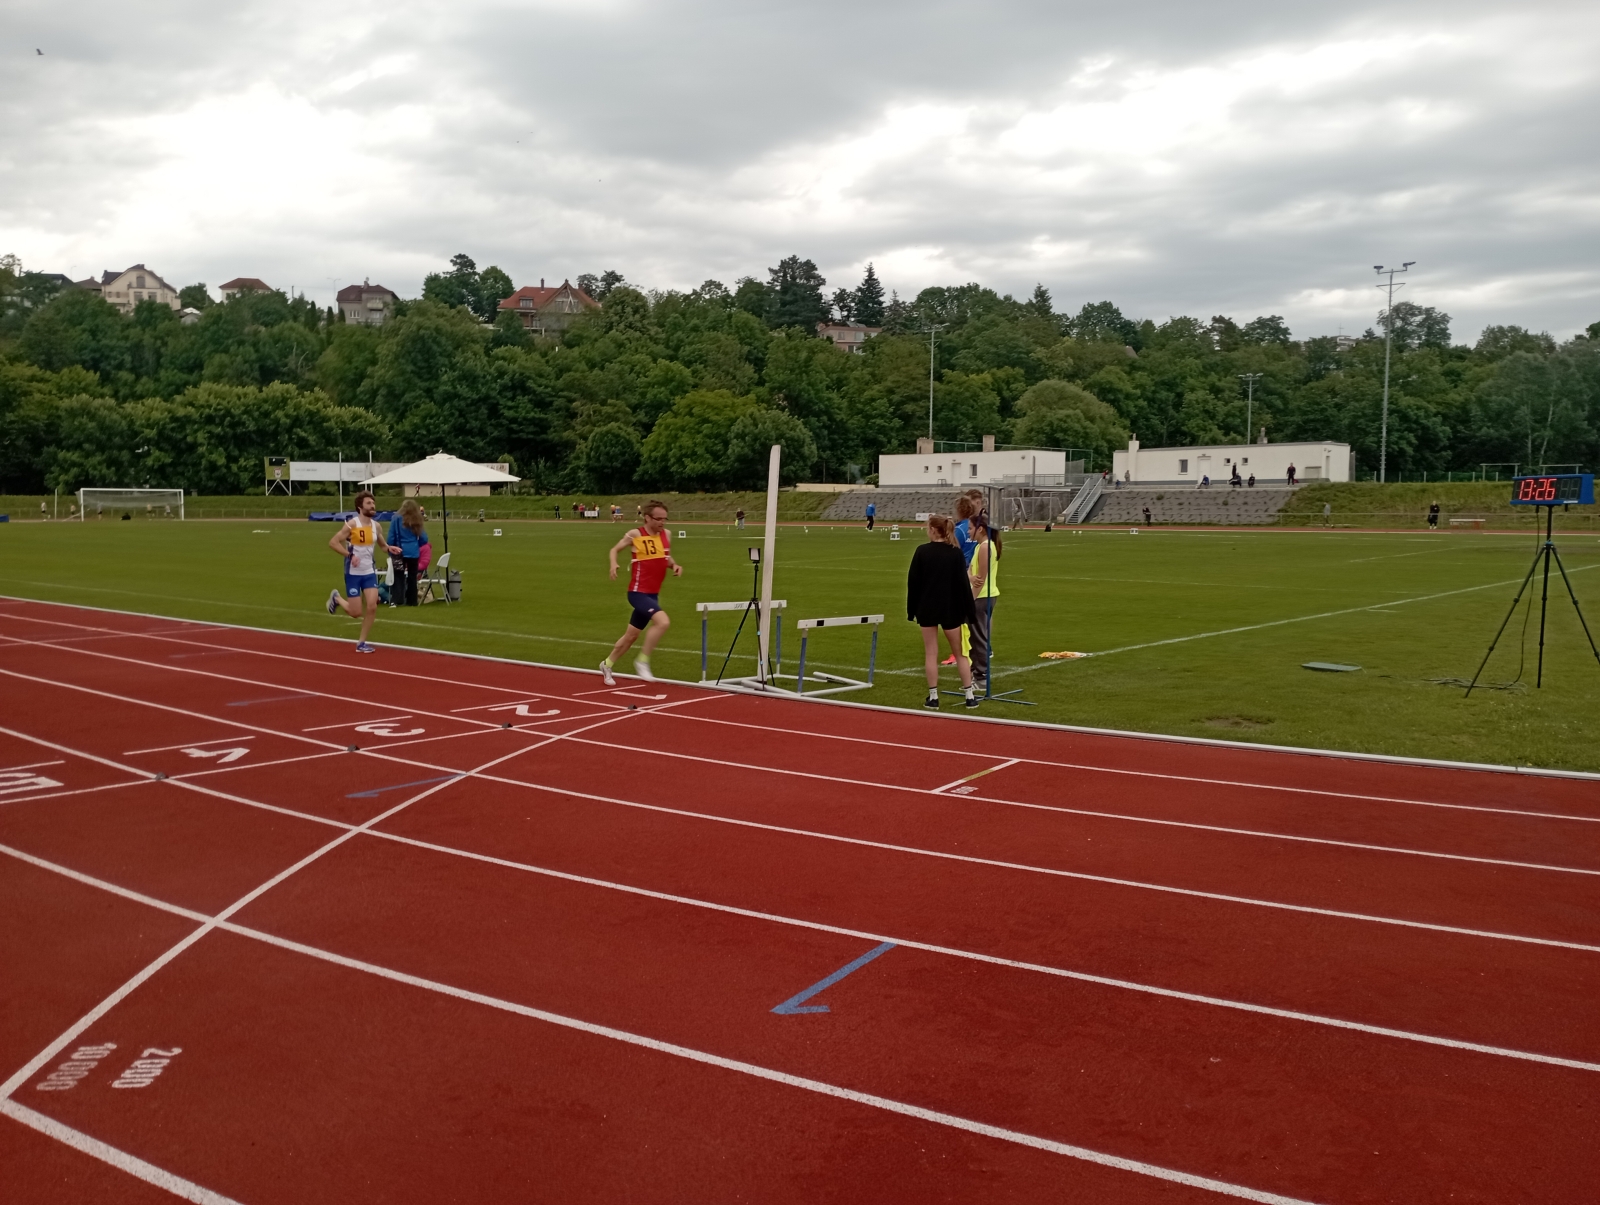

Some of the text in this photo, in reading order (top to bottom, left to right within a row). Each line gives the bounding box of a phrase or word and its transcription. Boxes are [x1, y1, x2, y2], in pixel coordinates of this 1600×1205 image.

[1518, 478, 1557, 501] 13:26
[359, 529, 366, 543] 9
[642, 539, 657, 556] 13
[487, 704, 560, 717] 2
[354, 723, 426, 737] 3
[180, 747, 251, 764] 4
